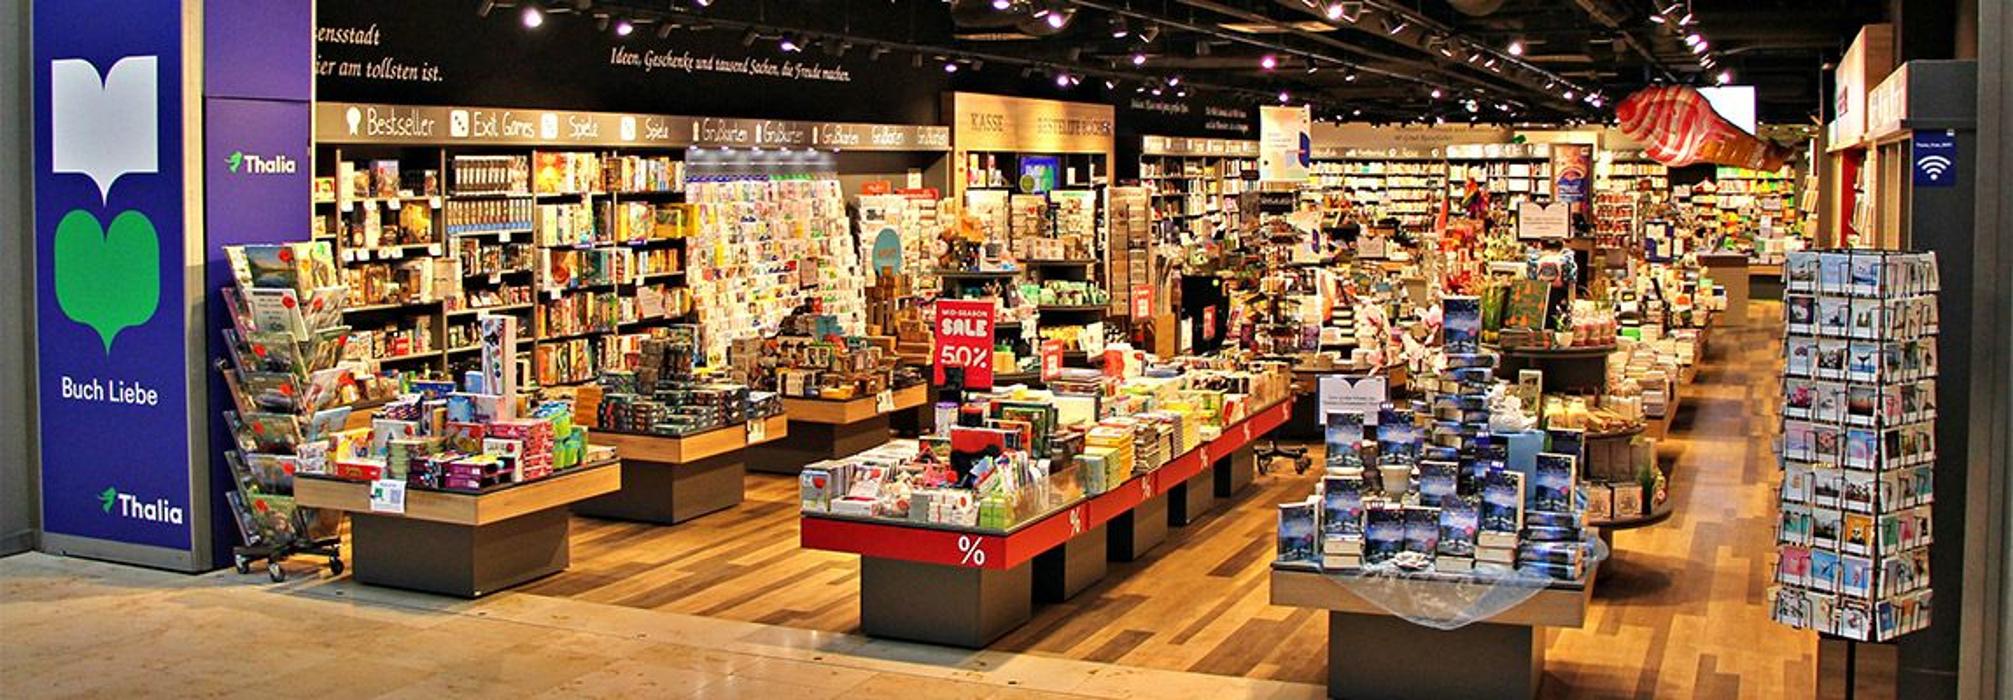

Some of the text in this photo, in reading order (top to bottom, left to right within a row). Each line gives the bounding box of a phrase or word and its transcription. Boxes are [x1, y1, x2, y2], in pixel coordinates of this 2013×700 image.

[317, 23, 380, 46] ensstadt
[339, 62, 362, 77] am
[366, 57, 419, 80] tollsten
[421, 61, 443, 81] ist.
[644, 49, 694, 73] Geschenke
[366, 107, 436, 137] Bestseller
[473, 111, 536, 139] Exit Games
[970, 112, 1004, 132] KASSE
[243, 153, 296, 174] Thalia
[941, 317, 988, 337] SALE
[941, 344, 988, 369] 50%
[62, 376, 159, 406] Buch Liebe
[118, 493, 183, 525] Thalia
[958, 534, 986, 566] %
